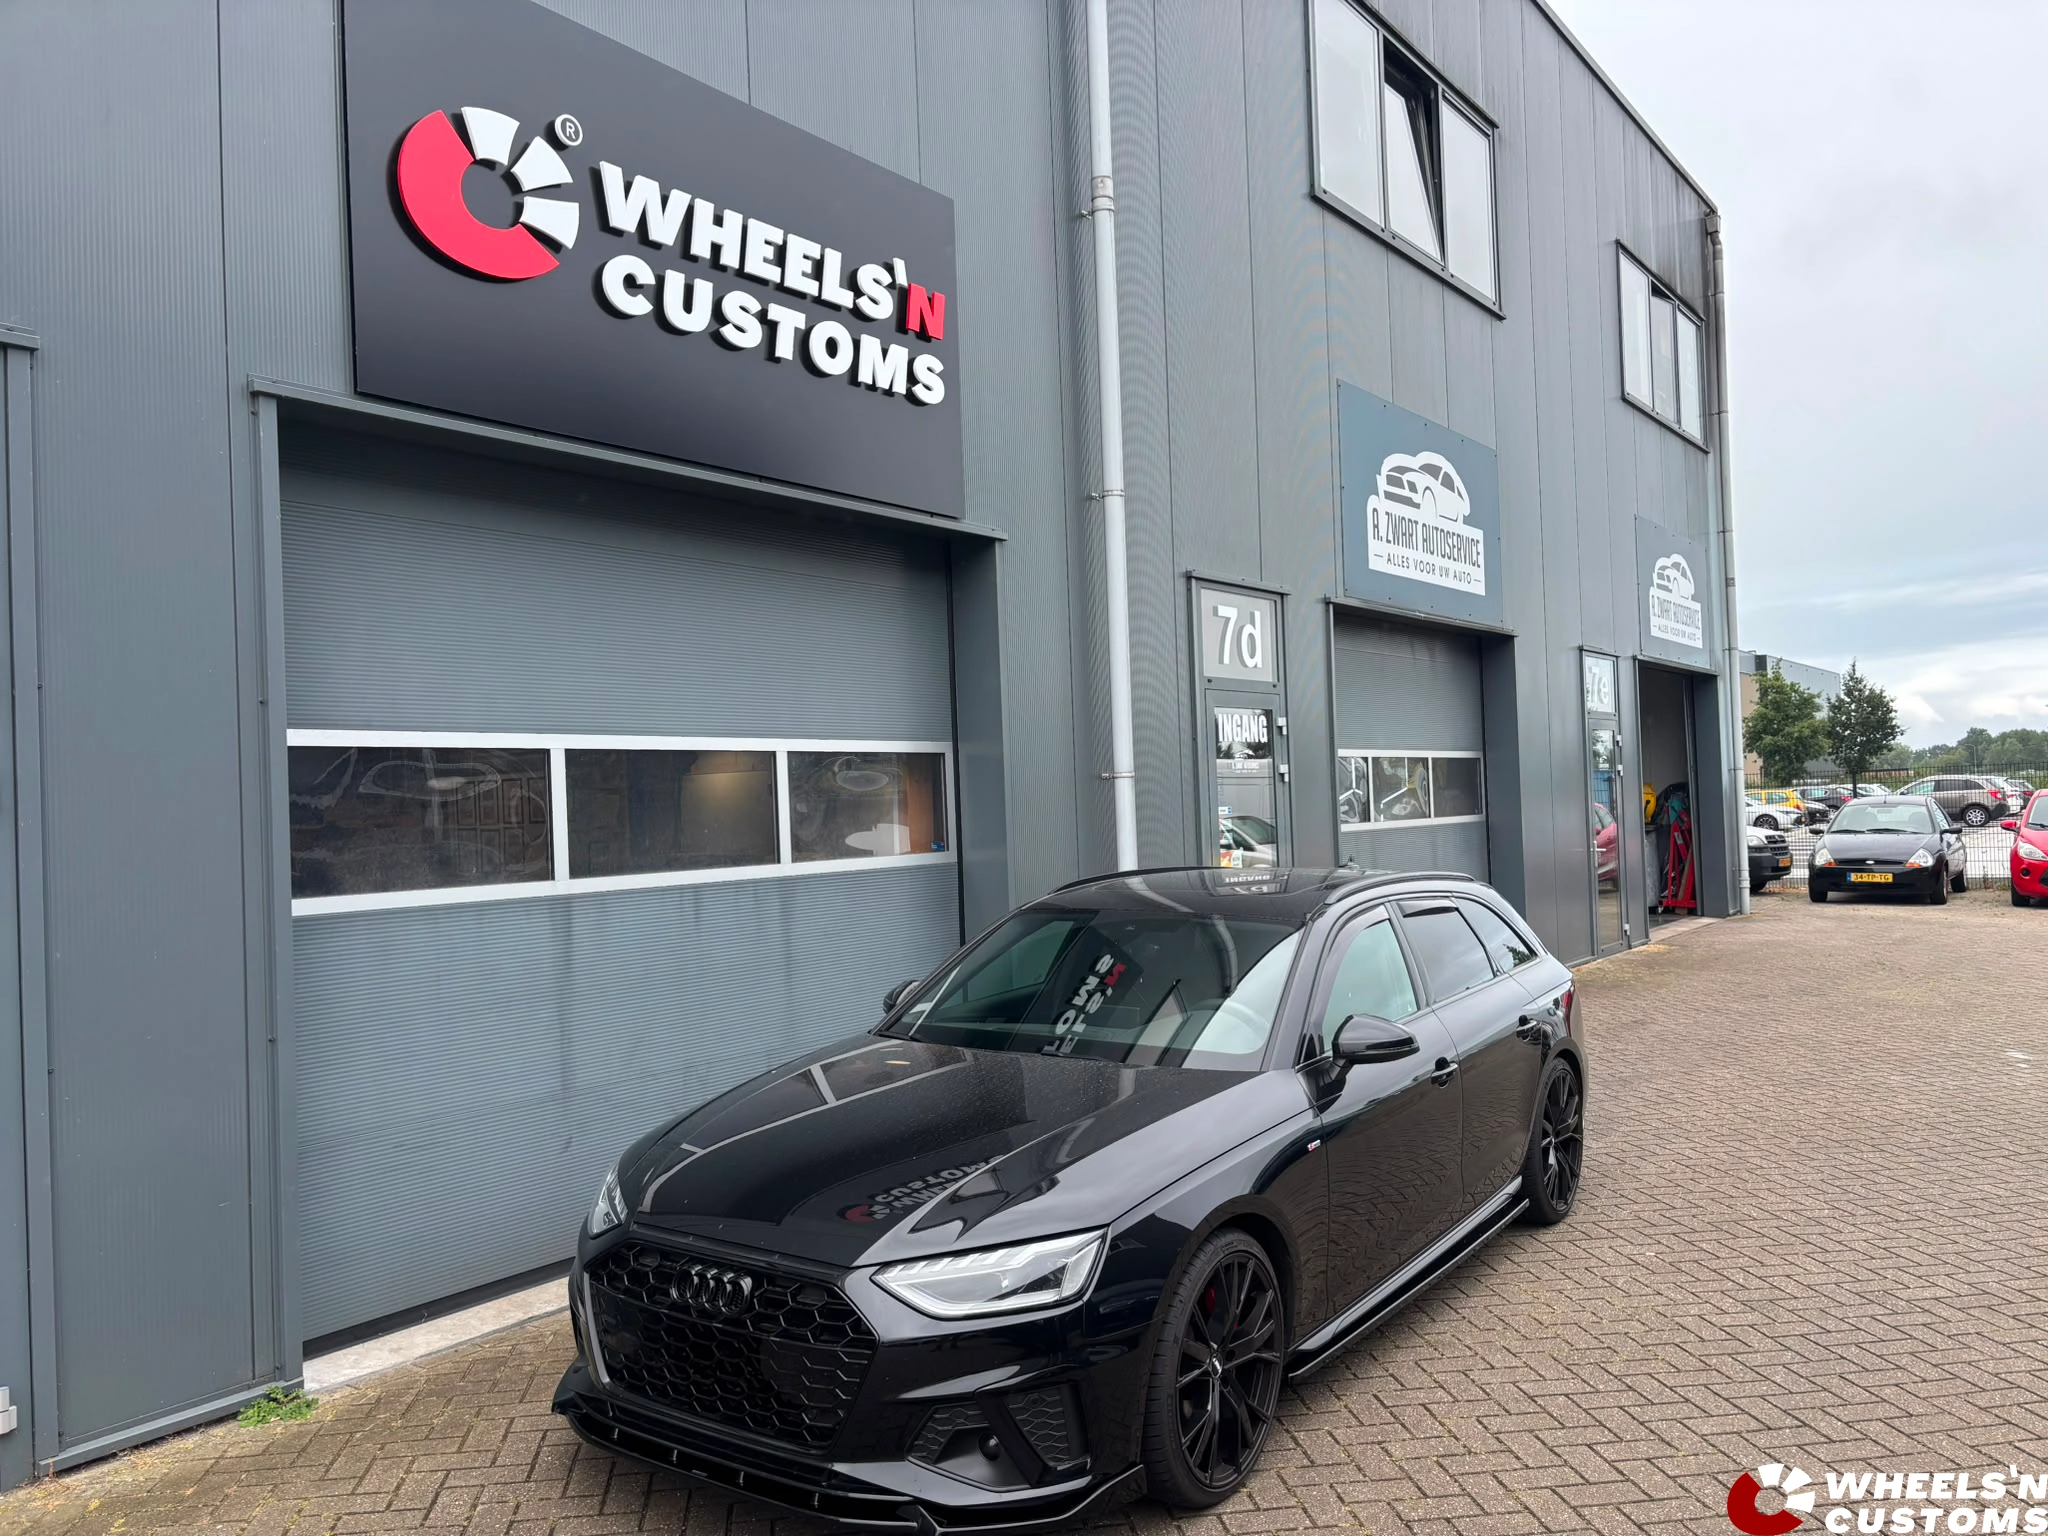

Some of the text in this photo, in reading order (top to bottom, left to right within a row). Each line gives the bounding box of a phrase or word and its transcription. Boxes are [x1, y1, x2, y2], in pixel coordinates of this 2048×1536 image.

[599, 160, 946, 341] WHEELS'N
[601, 254, 945, 405] CUSTOMS
[1372, 508, 1481, 569] A. ZWART AUTOSERVICE
[1387, 552, 1472, 585] ALLES VOOR UW AUTO
[1216, 604, 1263, 668] 7d
[1218, 712, 1268, 744] INGANG
[1853, 873, 1890, 882] 34-TP-TG
